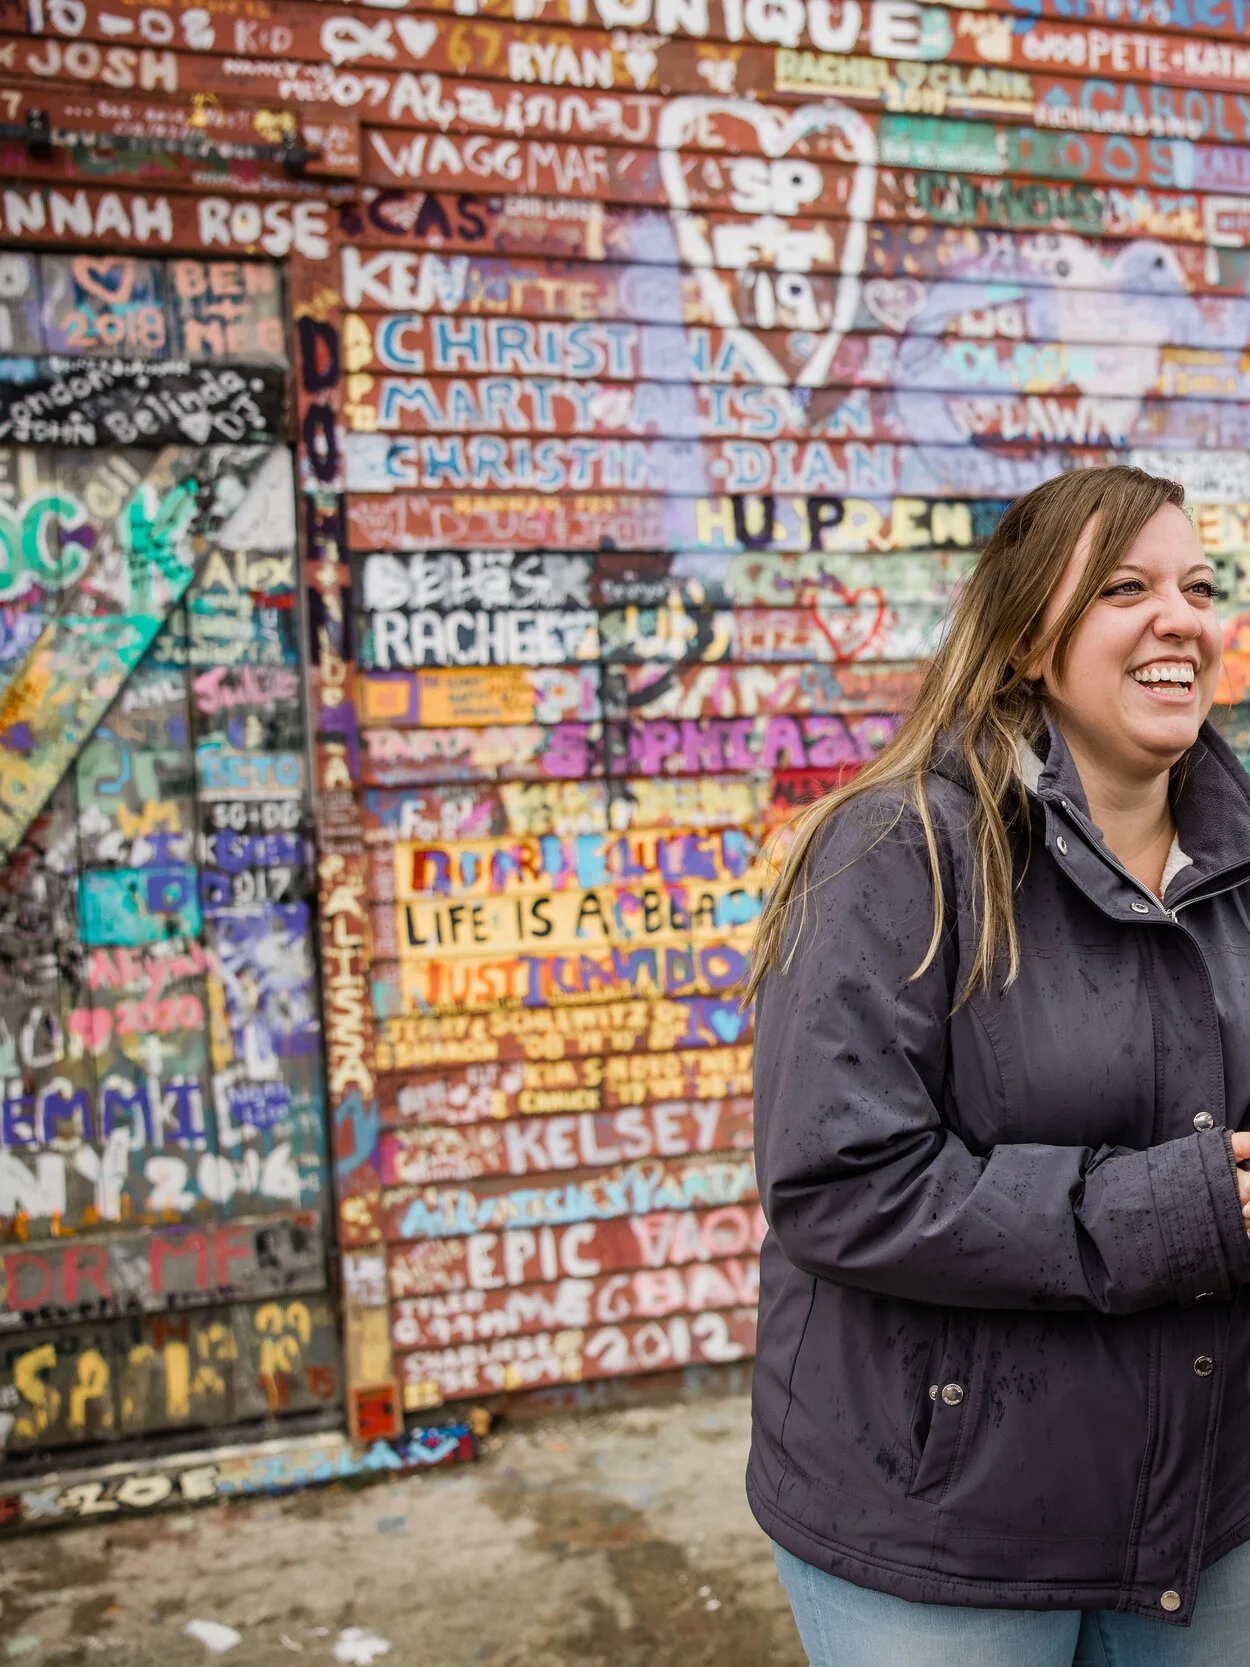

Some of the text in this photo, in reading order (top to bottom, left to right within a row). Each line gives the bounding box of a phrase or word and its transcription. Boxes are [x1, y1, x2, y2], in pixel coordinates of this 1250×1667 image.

[27, 41, 179, 93] JOSH
[507, 41, 614, 89] RYAN
[1088, 29, 1171, 75] PETE
[0, 189, 332, 261] NNAH ROSE
[340, 247, 471, 313] KEN
[60, 306, 167, 350] 2018
[202, 751, 302, 790] BETO
[404, 902, 490, 946] LIFE
[514, 895, 554, 940] IS
[505, 1097, 723, 1176] KELSEY
[466, 1220, 602, 1291] EPIC
[585, 1311, 745, 1372] 2012
